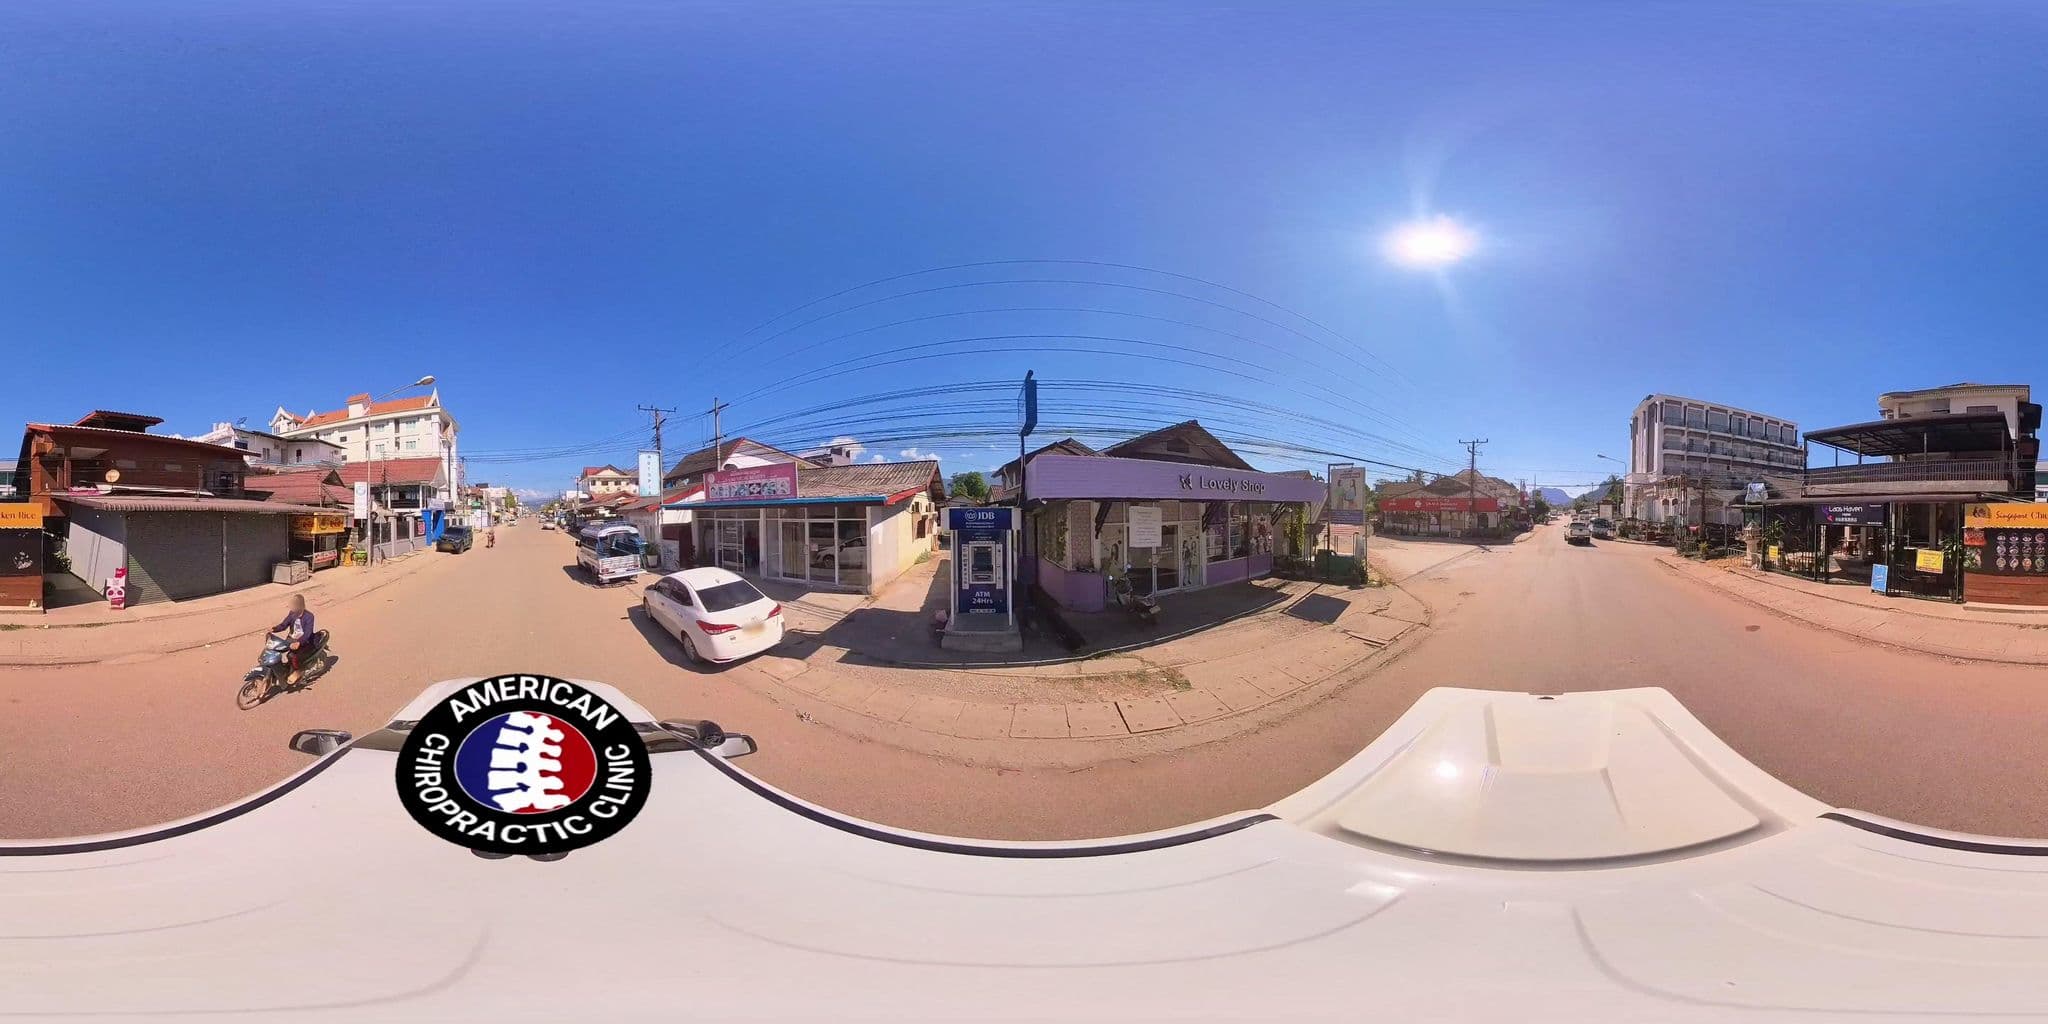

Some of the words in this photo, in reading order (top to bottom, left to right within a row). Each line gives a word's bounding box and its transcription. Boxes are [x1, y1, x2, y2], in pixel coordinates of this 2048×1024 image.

[1200, 476, 1239, 492] Lovely
[1241, 480, 1266, 494] Shop
[19, 511, 36, 519] Rice
[978, 512, 995, 520] JDB
